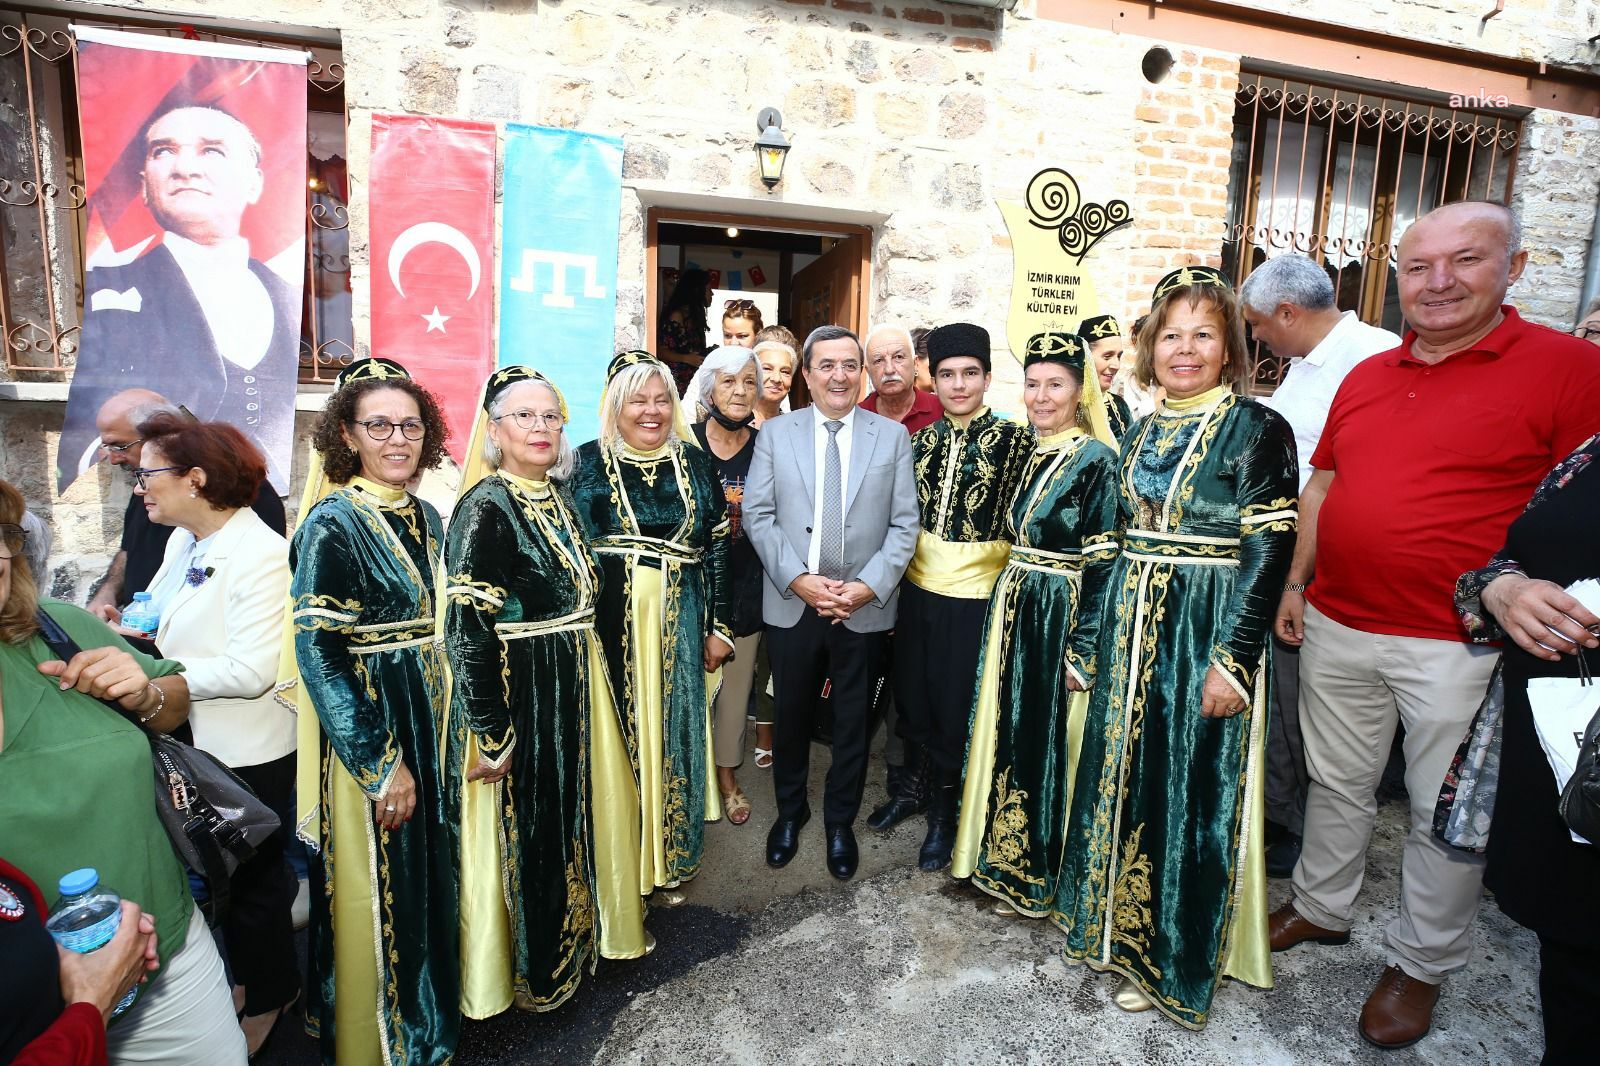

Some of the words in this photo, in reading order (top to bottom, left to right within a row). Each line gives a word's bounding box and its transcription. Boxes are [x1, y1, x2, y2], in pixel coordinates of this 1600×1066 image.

[1027, 269, 1053, 284] İZMİR
[1055, 274, 1081, 286] KIRIM
[1031, 286, 1075, 301] TÜRKLERİ
[1026, 301, 1062, 314] KÜLTÜR
[1063, 303, 1078, 316] EVİ
